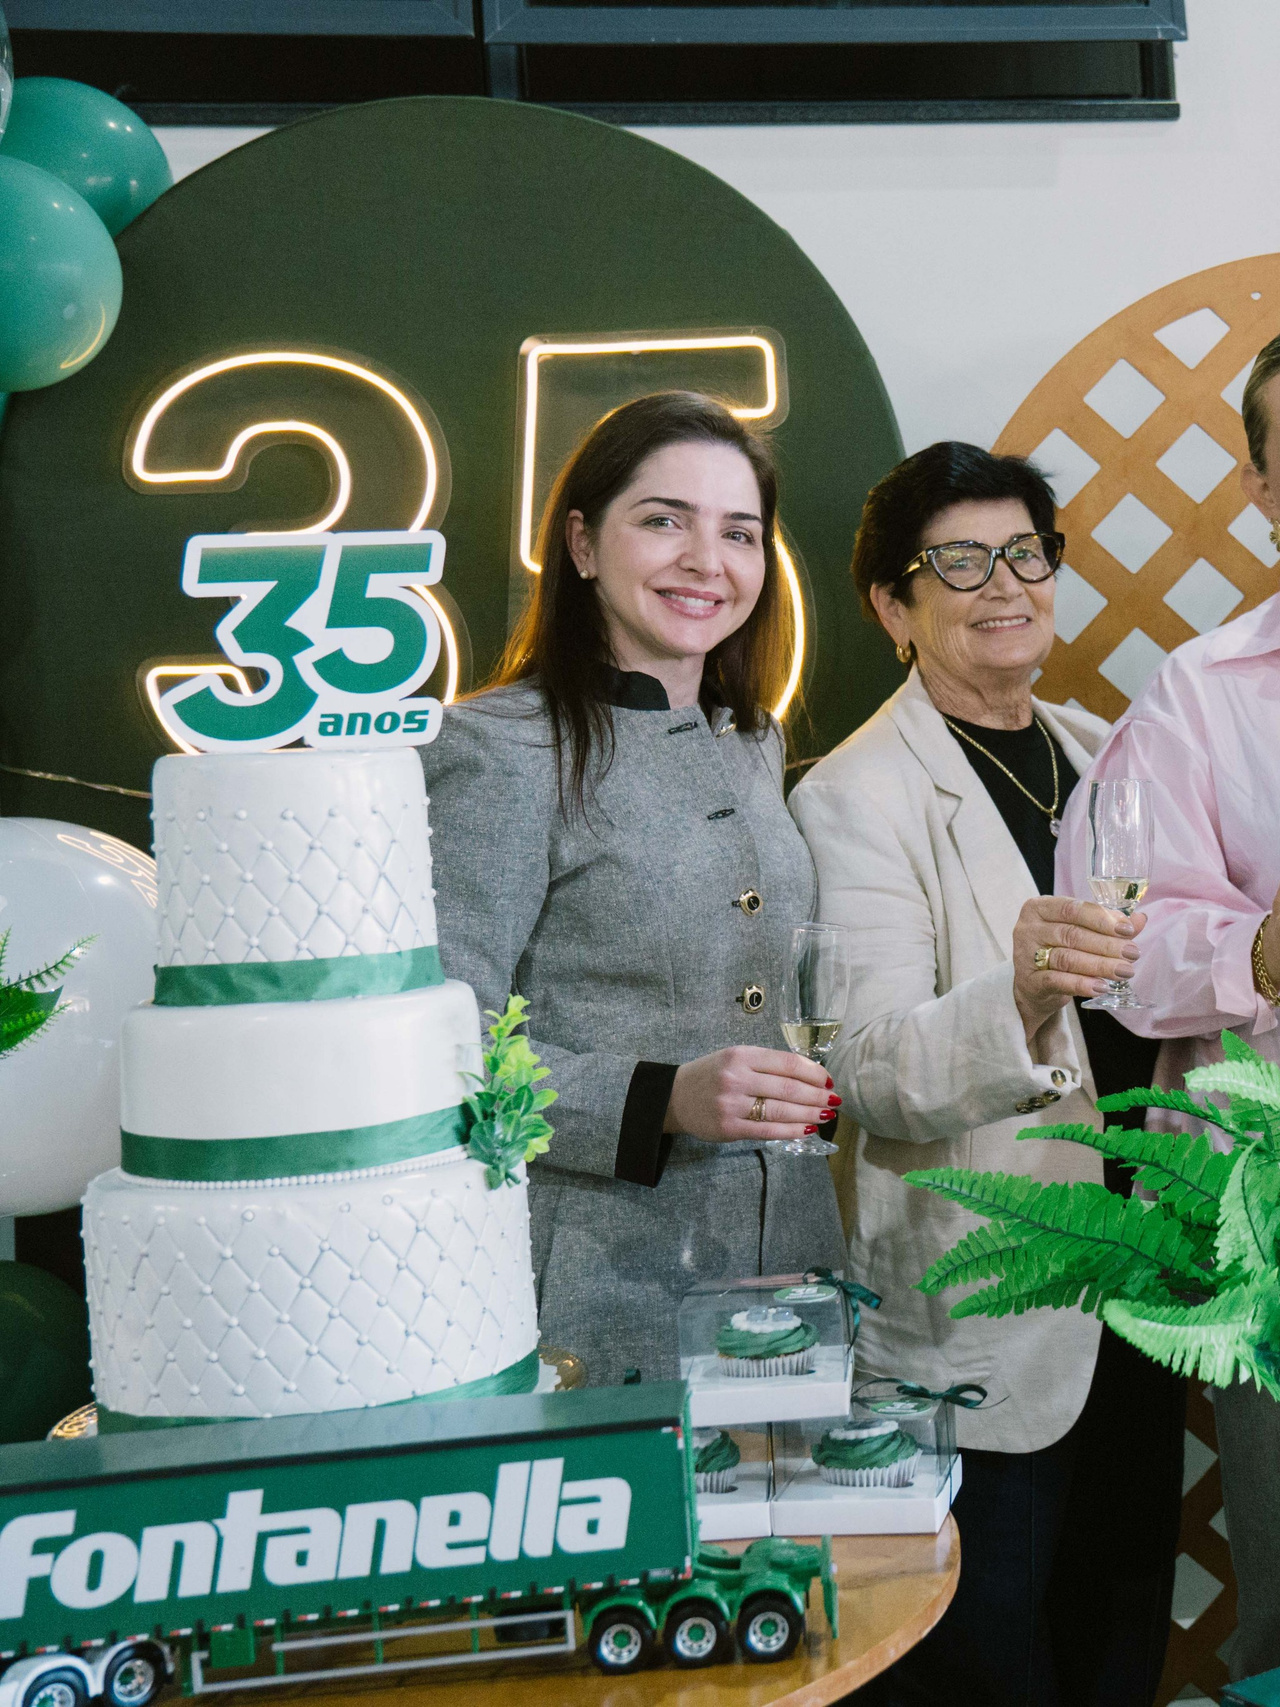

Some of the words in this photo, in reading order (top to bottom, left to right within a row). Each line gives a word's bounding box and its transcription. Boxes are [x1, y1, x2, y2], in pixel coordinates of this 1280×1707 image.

[171, 542, 436, 742] 35
[318, 709, 430, 736] anos
[0, 1457, 633, 1619] Fontanella
